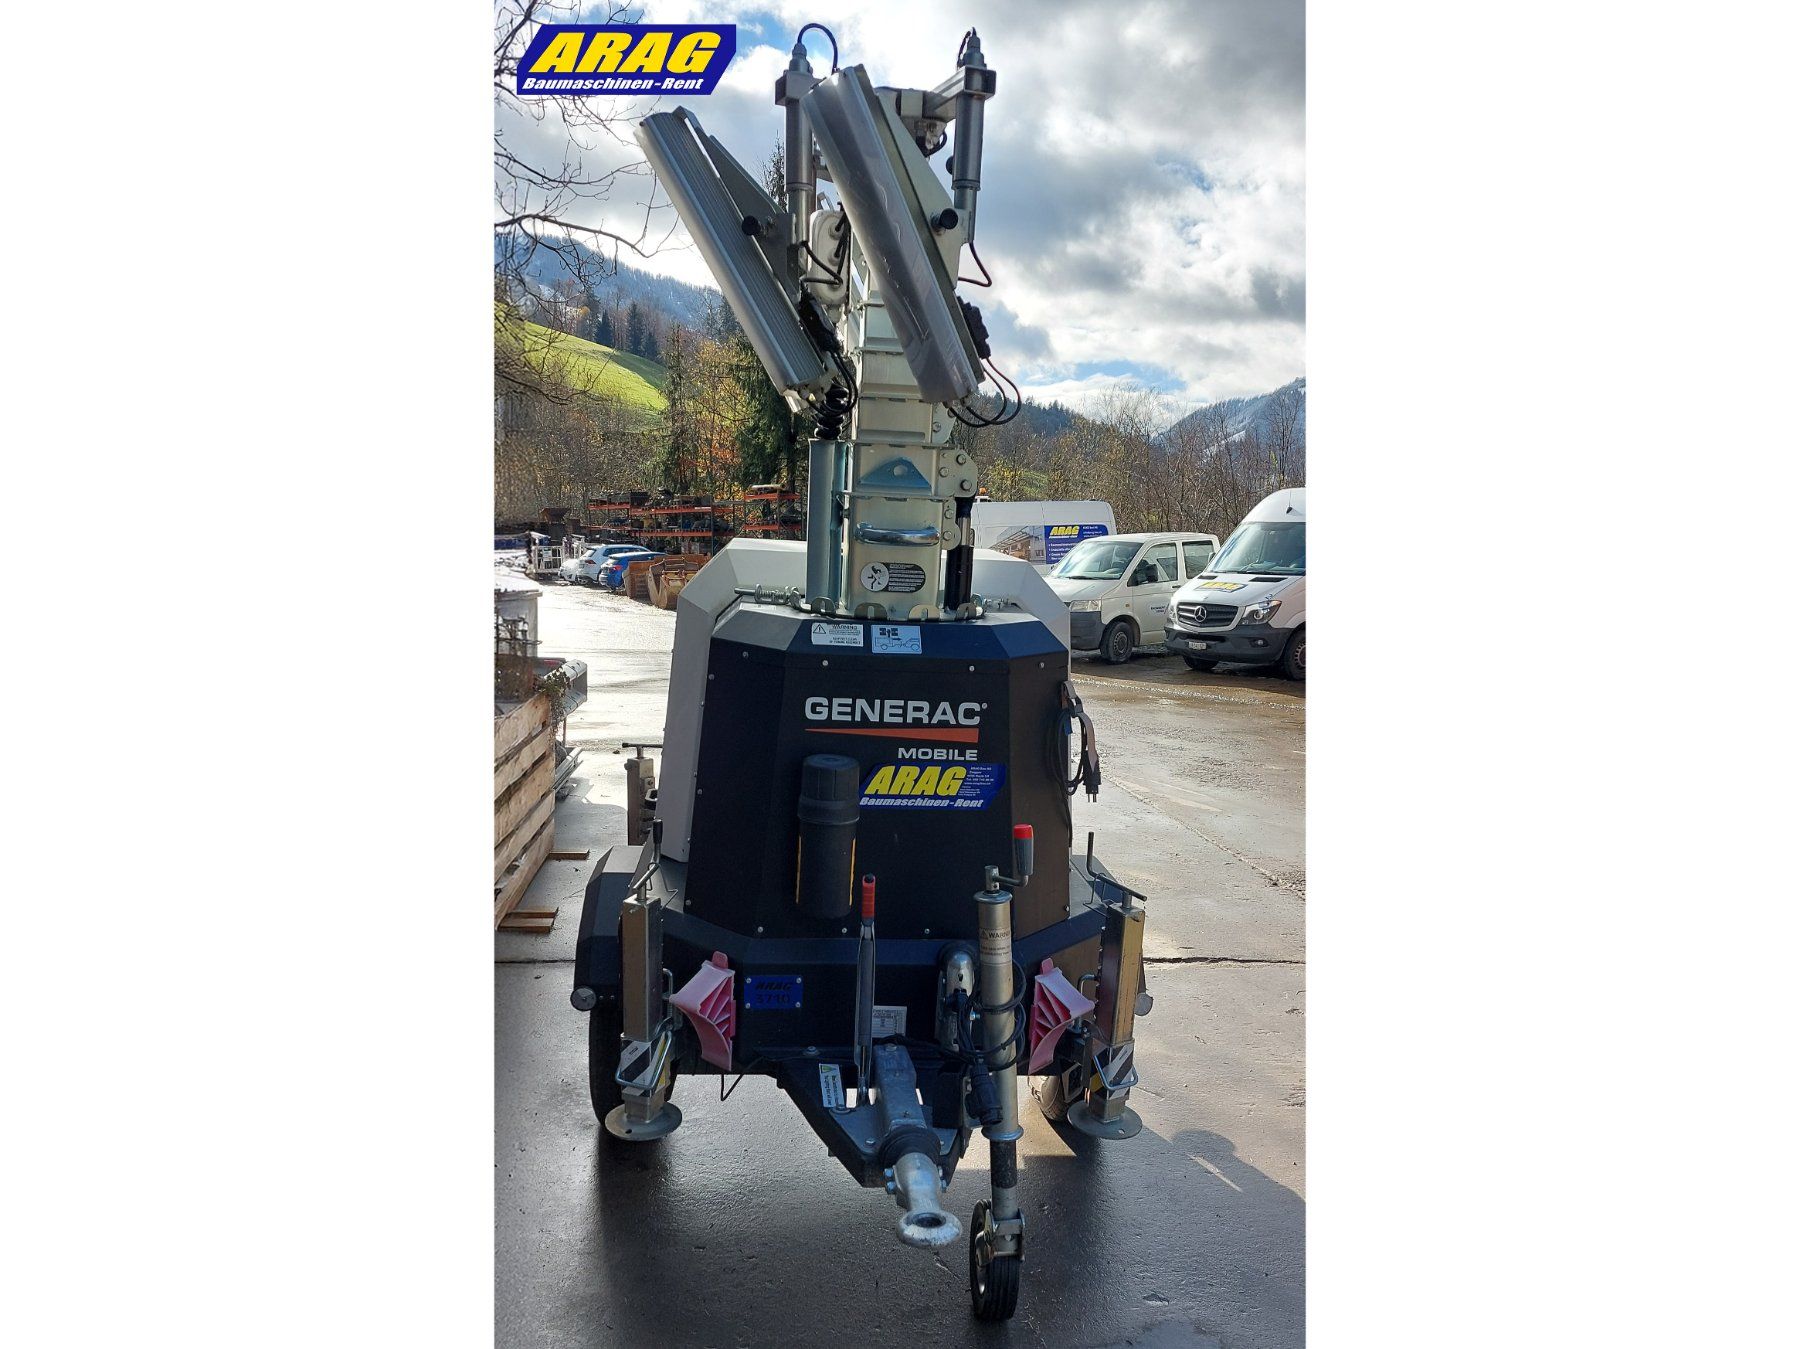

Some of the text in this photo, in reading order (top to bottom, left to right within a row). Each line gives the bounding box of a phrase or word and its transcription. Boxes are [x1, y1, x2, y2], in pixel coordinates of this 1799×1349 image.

[1050, 525, 1080, 535] ARAG
[804, 696, 982, 726] GENERAC
[897, 747, 978, 761] MOBILE
[864, 765, 967, 796] ARAG
